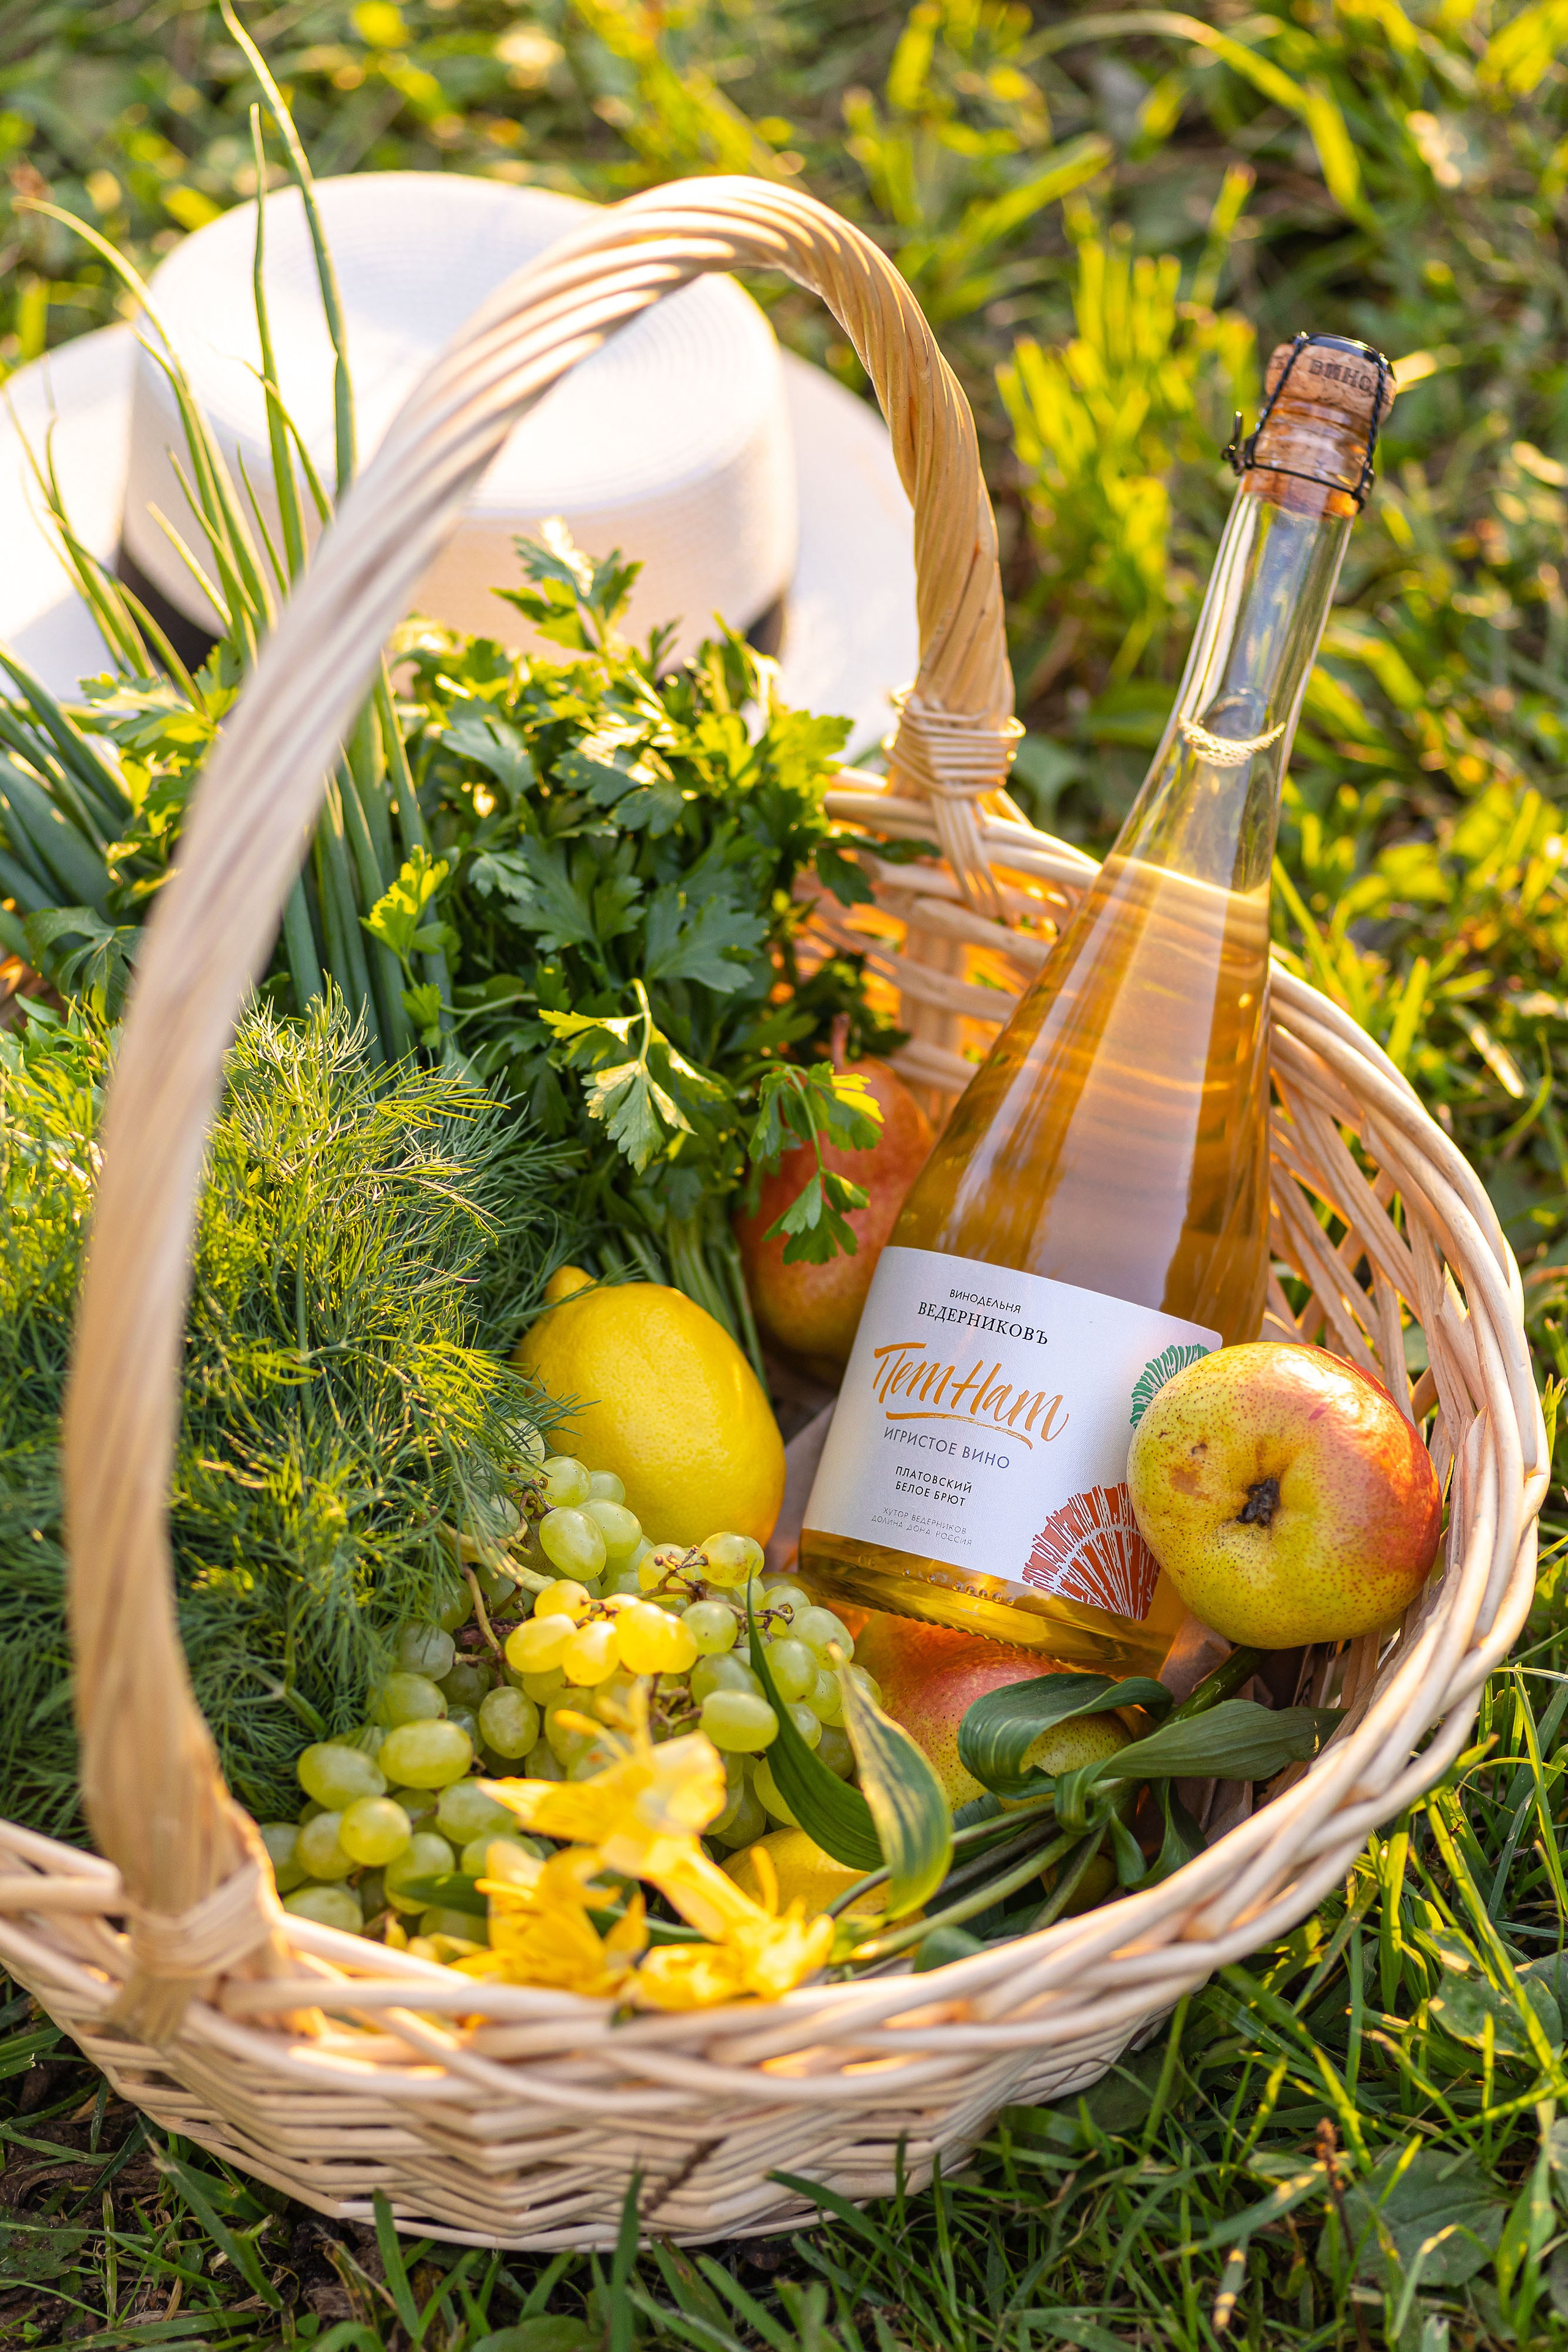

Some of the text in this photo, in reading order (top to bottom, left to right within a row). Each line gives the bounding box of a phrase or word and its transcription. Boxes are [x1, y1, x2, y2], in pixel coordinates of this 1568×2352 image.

[949, 1289, 1021, 1313] ВИНОДЕЛЬНЯ
[918, 1301, 1048, 1344] ВЕДЕРНИКОВЪ
[884, 1427, 1009, 1469] ИГРИСТОЕ ВИНО
[895, 1466, 972, 1493] ПЛАТОВСКИЙ
[895, 1481, 966, 1506] БЕЛОЕ БРЮТ
[872, 1515, 972, 1546] ДОЛИНА ДОНА РОССИЯ
[883, 1507, 967, 1534] ХУТОР ВЕДЕРНИКОВ
